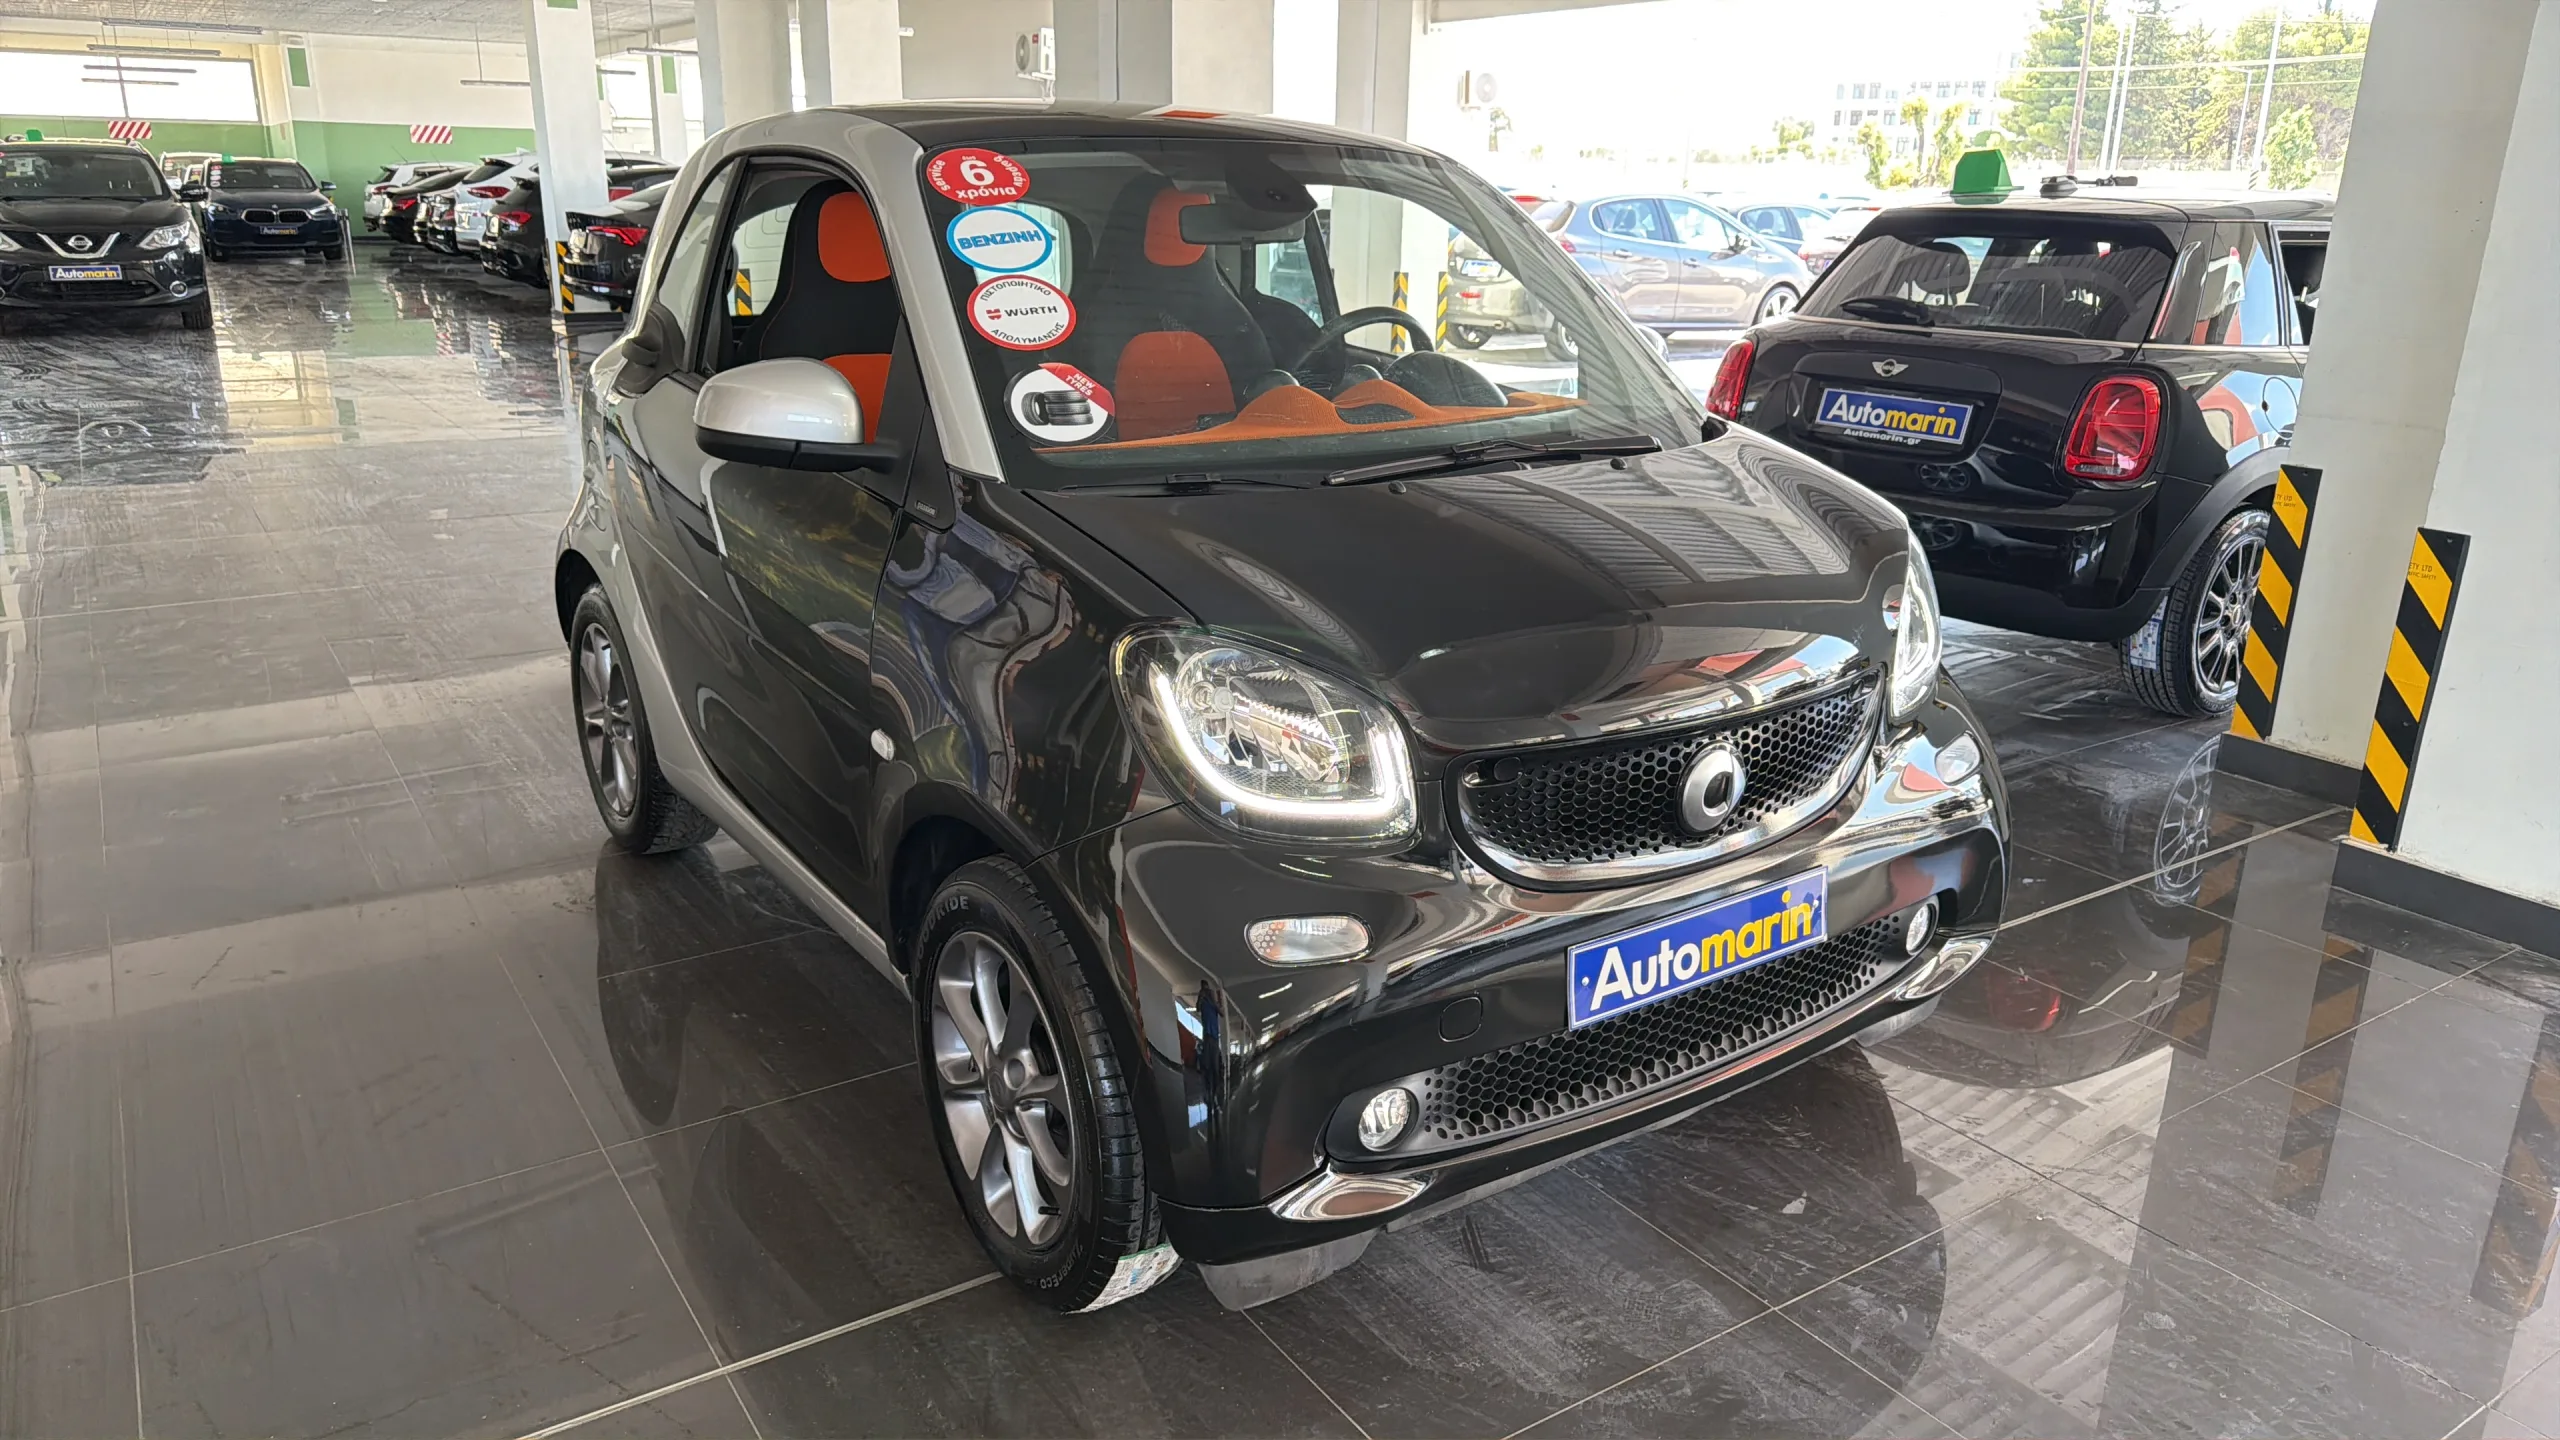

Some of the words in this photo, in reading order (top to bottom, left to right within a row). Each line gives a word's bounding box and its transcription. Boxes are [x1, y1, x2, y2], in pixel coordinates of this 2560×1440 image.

[929, 160, 951, 191] service
[960, 159, 995, 186] 6
[993, 155, 1027, 188] δωρεάν
[955, 186, 1018, 200] χρόνια
[263, 226, 297, 235] Automarin
[56, 267, 117, 279] Automarin
[1065, 375, 1093, 396] TYRES
[1073, 373, 1096, 389] NEW
[1827, 394, 1957, 436] Automarin
[1844, 429, 1921, 445] Automarin.gr
[2421, 564, 2433, 573] LTD
[1590, 890, 1813, 1011] Automarin
